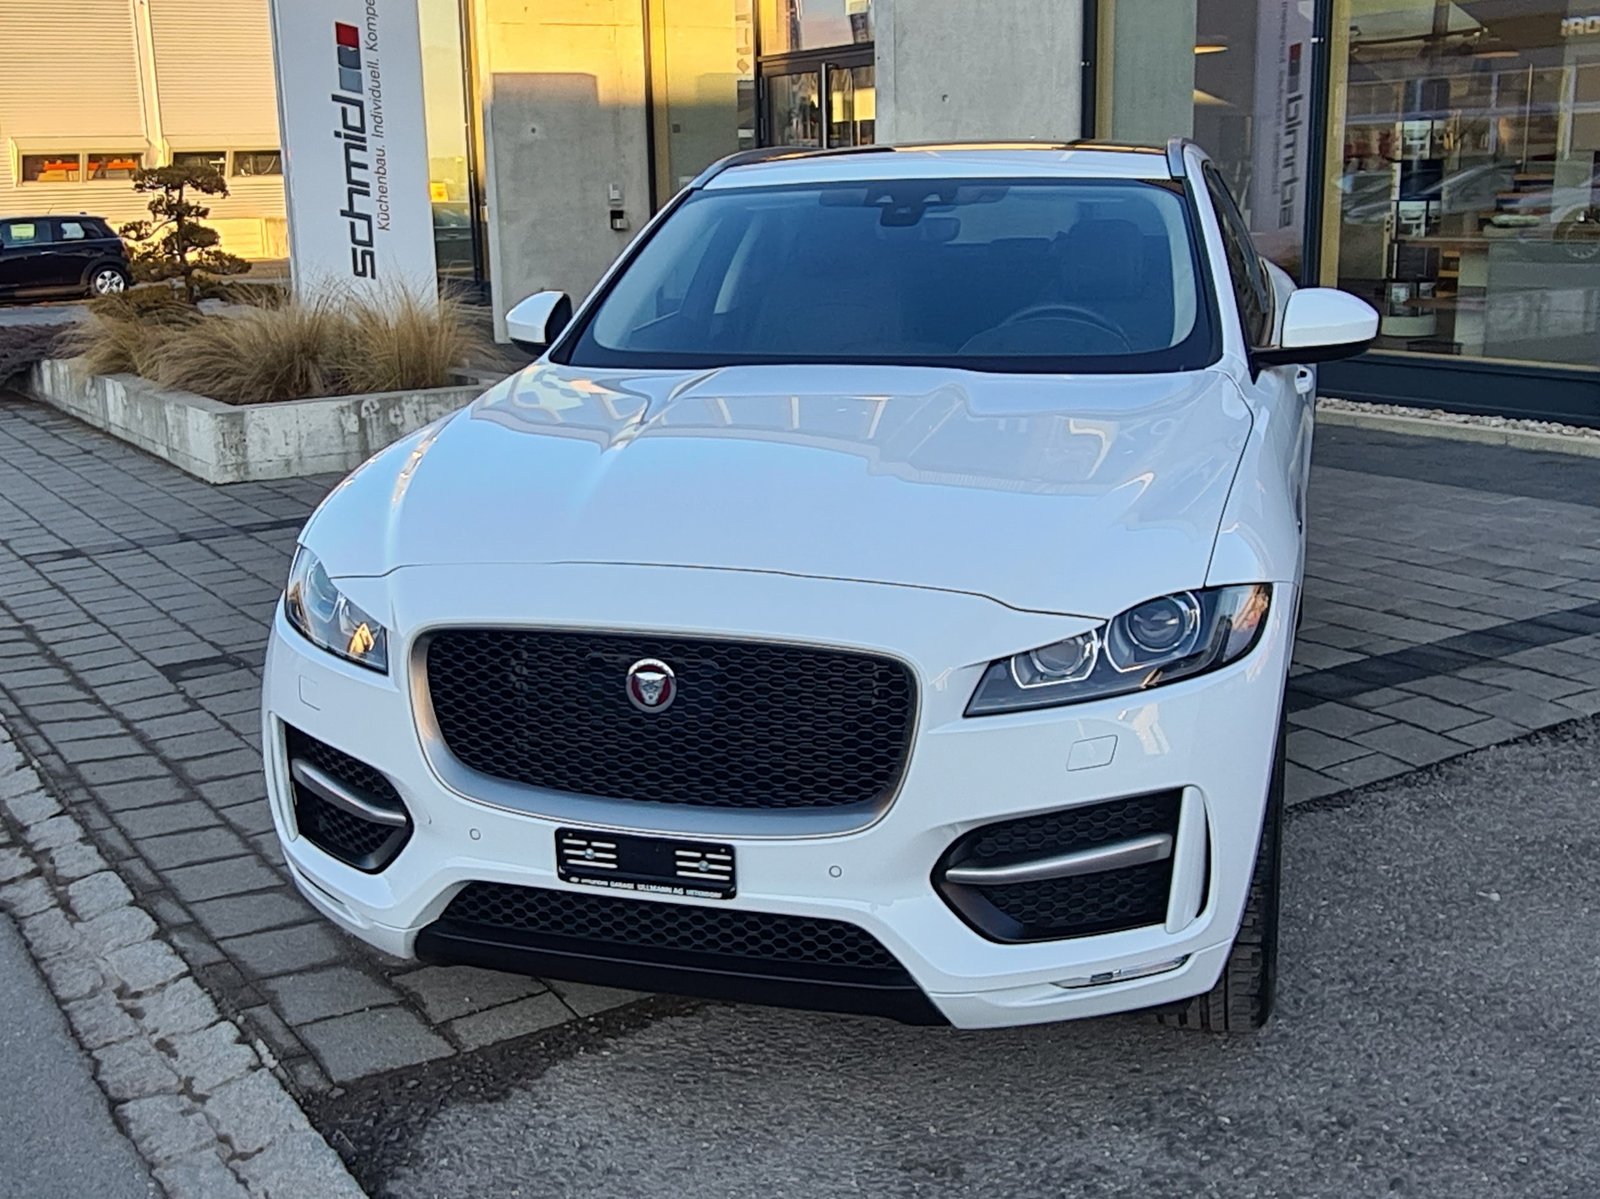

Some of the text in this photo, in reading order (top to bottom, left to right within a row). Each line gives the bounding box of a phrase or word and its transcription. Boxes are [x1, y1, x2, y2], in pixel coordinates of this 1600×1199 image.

[367, 58, 384, 138] Individuell.
[331, 94, 376, 280] schmid
[372, 144, 390, 231] Küchenbau.
